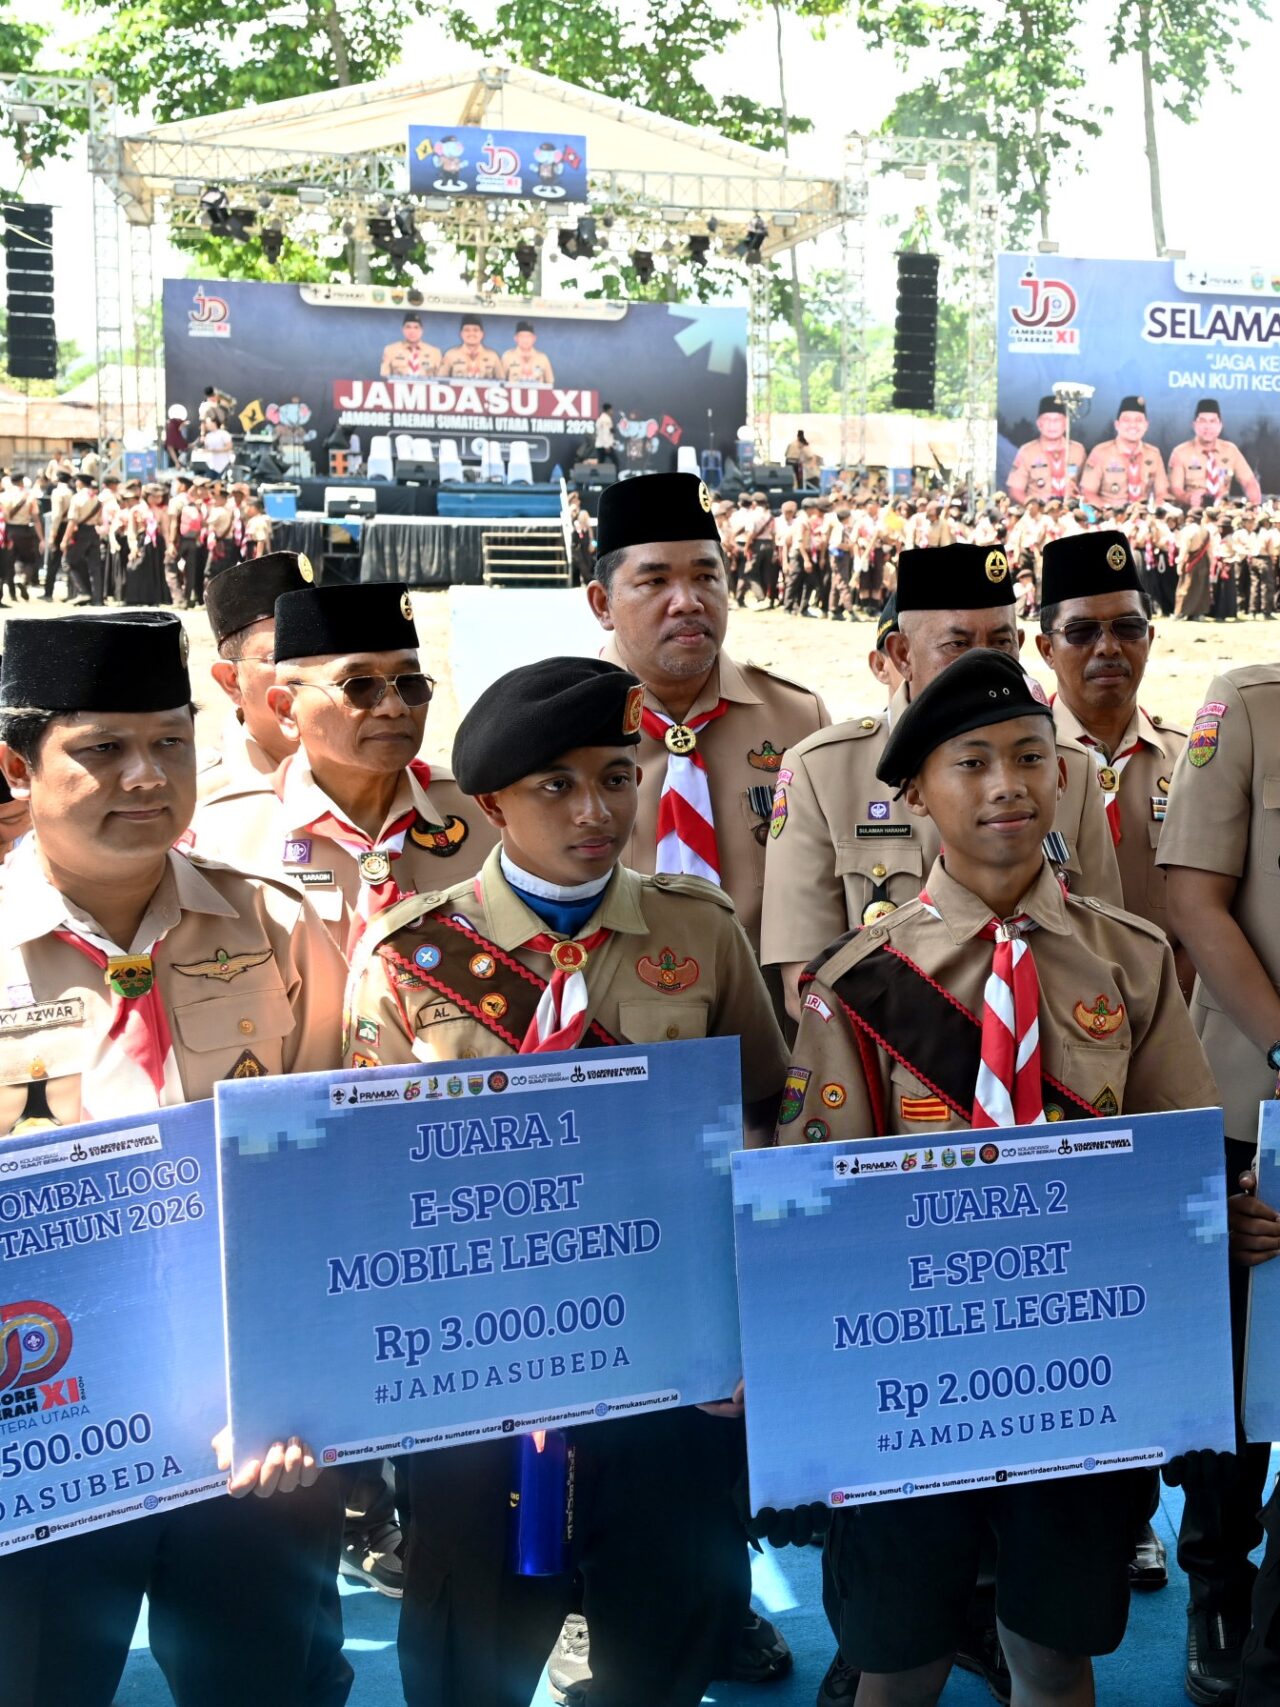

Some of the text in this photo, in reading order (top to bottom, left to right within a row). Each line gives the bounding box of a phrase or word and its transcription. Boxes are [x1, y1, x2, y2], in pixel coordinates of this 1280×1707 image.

[1056, 330, 1075, 344] XI
[338, 380, 592, 418] JAMDASU XI
[1168, 371, 1205, 389] DAN
[1209, 373, 1248, 390] IKUTI
[339, 411, 391, 427] JAMBORE
[393, 413, 435, 429] DAERAH
[436, 415, 493, 431] SUMATERA
[495, 417, 529, 433] UTARA
[531, 418, 565, 434] TAHUN
[26, 1005, 73, 1022] AZWAR
[360, 1090, 399, 1100] PRAMUKA
[409, 1109, 580, 1162] JUARA 1
[106, 1157, 200, 1200] LOGO
[860, 1160, 898, 1171] PRAMUKA
[411, 1173, 584, 1229] E-SPORT
[906, 1180, 1068, 1229] JUARA 2
[0, 1191, 205, 1261] TAHUN 2026
[326, 1218, 661, 1295] MOBILE LEGEND
[908, 1240, 1072, 1291] E-SPORT
[375, 1292, 626, 1367] Rp 3.000.000
[833, 1284, 1146, 1352] MOBILE LEGEND
[38, 1377, 80, 1411] XI
[374, 1345, 631, 1405] #JAMDASUBEDA
[877, 1354, 1112, 1418] Rp 2.000.000
[41, 1404, 91, 1425] UTARA
[337, 1393, 678, 1458] @kwarda_sumut kwarda sumatera utara @kwartirdaerahsumut Pramukasumut.or.id
[876, 1404, 1118, 1453] #JAMDASUBEDA
[844, 1451, 1164, 1500] @kwarda_sumut kwarda sumatera utara @kwartirdaerahsumut Pramukasumut.or.id
[11, 1532, 35, 1545] utara
[50, 1501, 144, 1533] @kwartirdaerahsumut
